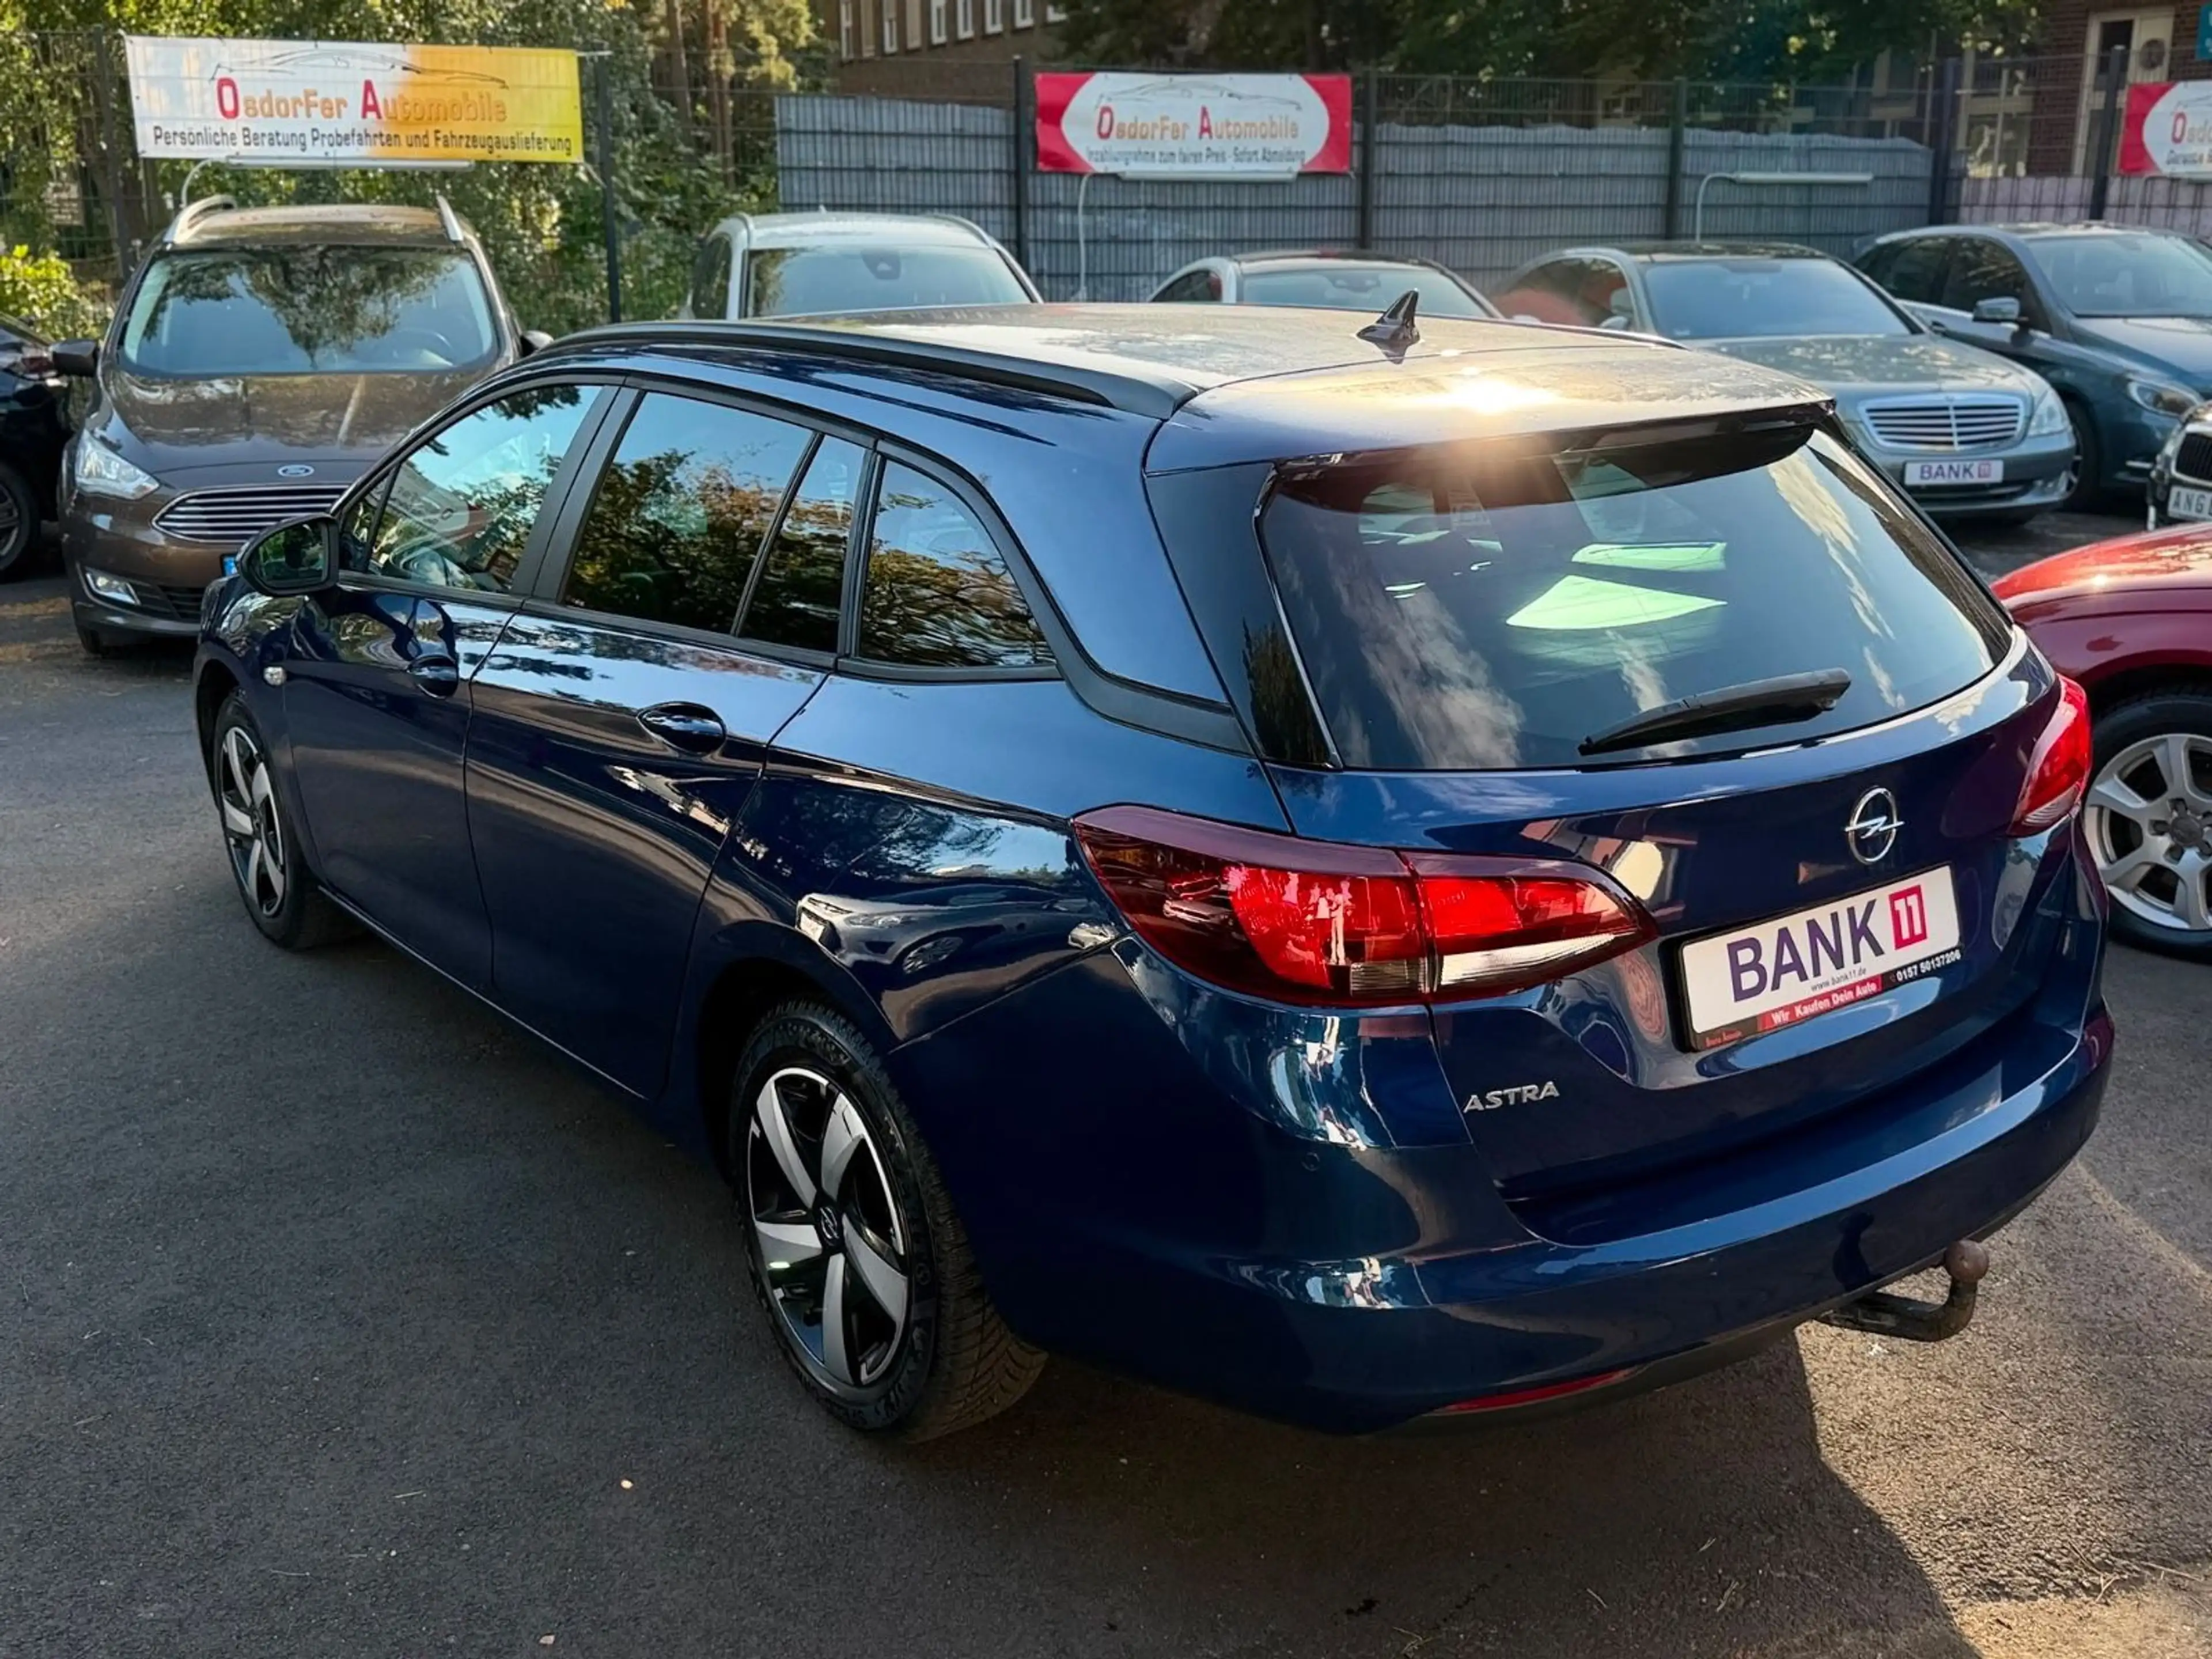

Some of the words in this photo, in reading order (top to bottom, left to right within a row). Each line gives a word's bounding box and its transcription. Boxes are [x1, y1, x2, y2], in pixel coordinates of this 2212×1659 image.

[361, 79, 507, 122] Automobile
[1198, 105, 1299, 140] Automobile
[153, 125, 237, 146] Persönliche
[241, 127, 307, 152] Beratung
[311, 127, 402, 148] Probefahrten
[405, 130, 430, 148] und
[434, 129, 572, 156] Fahrzeugauslieferung
[1919, 463, 1975, 480] BANK
[1727, 899, 1885, 1002] BANK
[1892, 890, 1925, 945] 11
[1811, 967, 1866, 993] www.bank11.de
[1896, 964, 1918, 982] 0157
[1771, 1010, 1791, 1025] Wir
[1794, 997, 1830, 1017] Kaufen
[1831, 988, 1854, 1004] Dein
[1855, 981, 1877, 997] Auto
[1463, 1081, 1560, 1113] ASTRA
